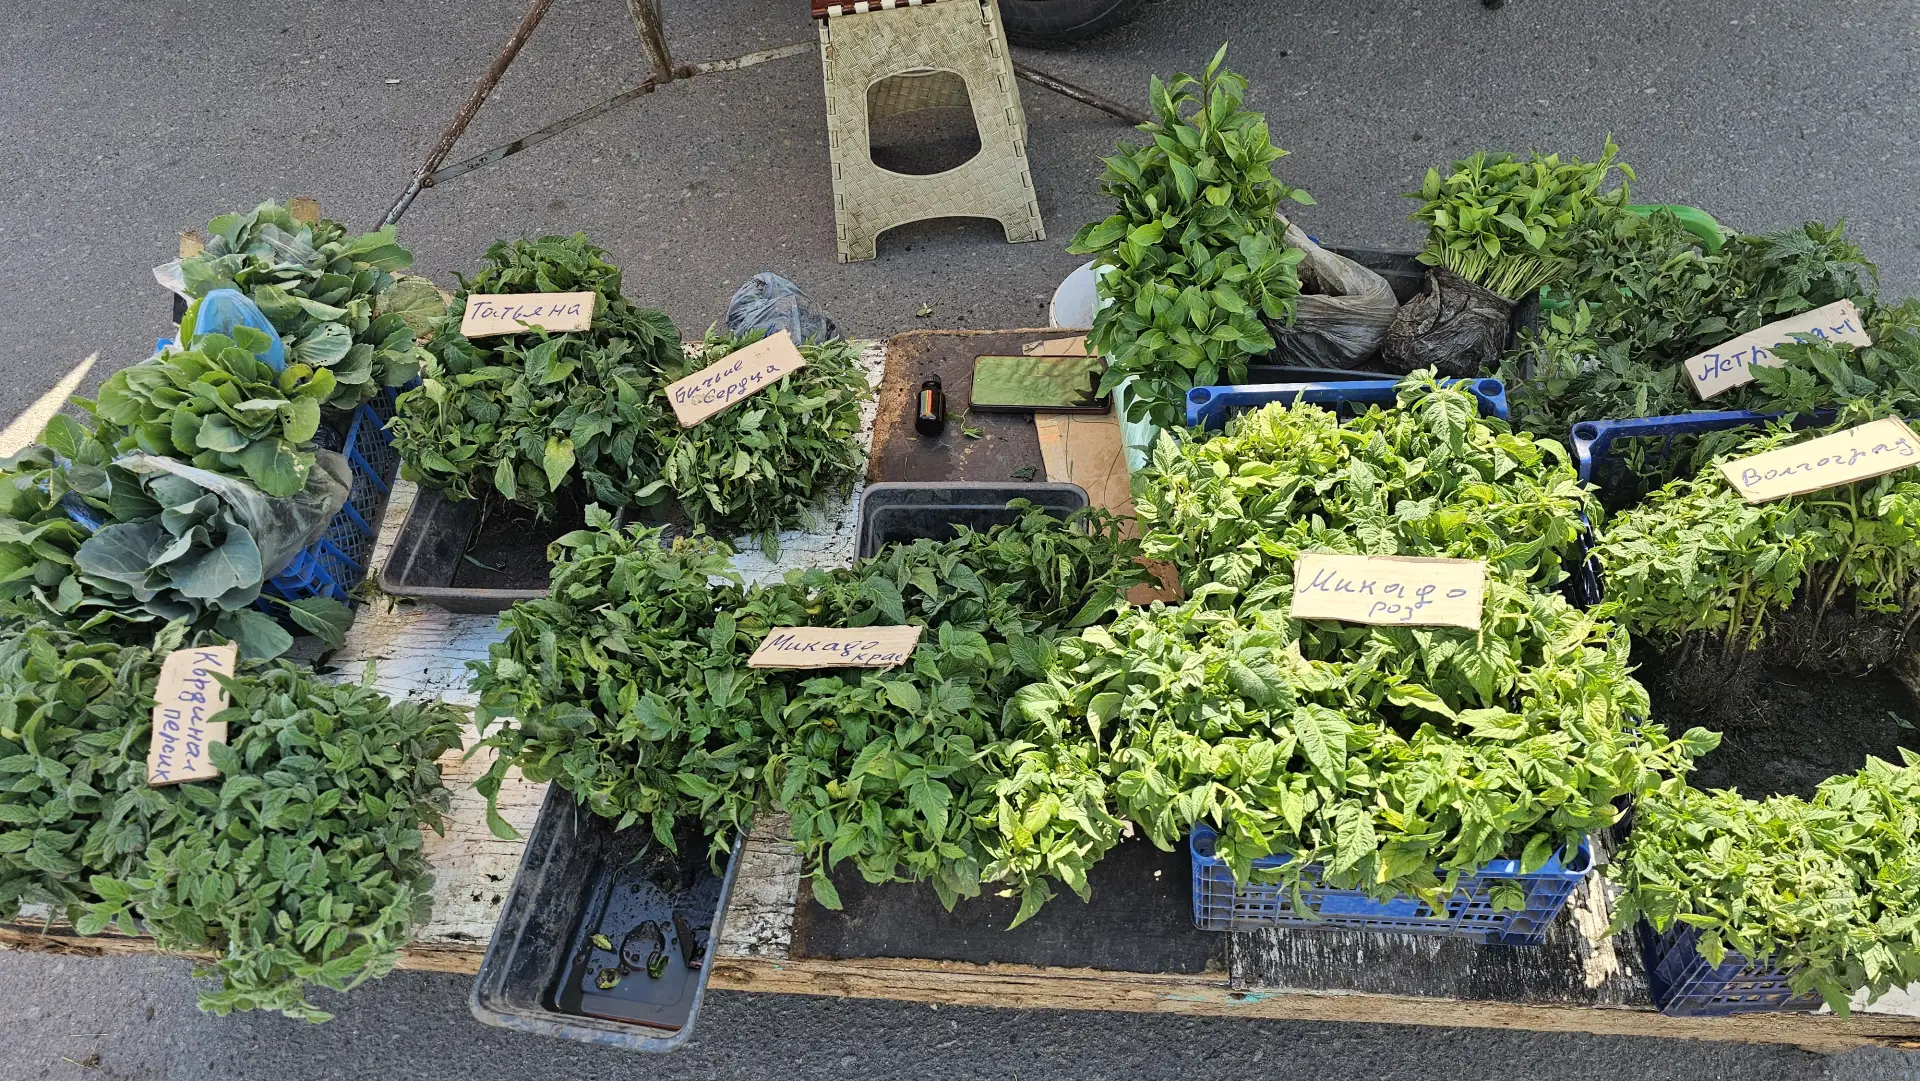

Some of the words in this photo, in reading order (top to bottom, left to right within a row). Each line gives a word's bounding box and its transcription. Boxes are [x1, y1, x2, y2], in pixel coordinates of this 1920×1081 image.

[1300, 568, 1467, 609] Микадо
[761, 634, 880, 657] Микадо
[149, 708, 182, 782] персик
